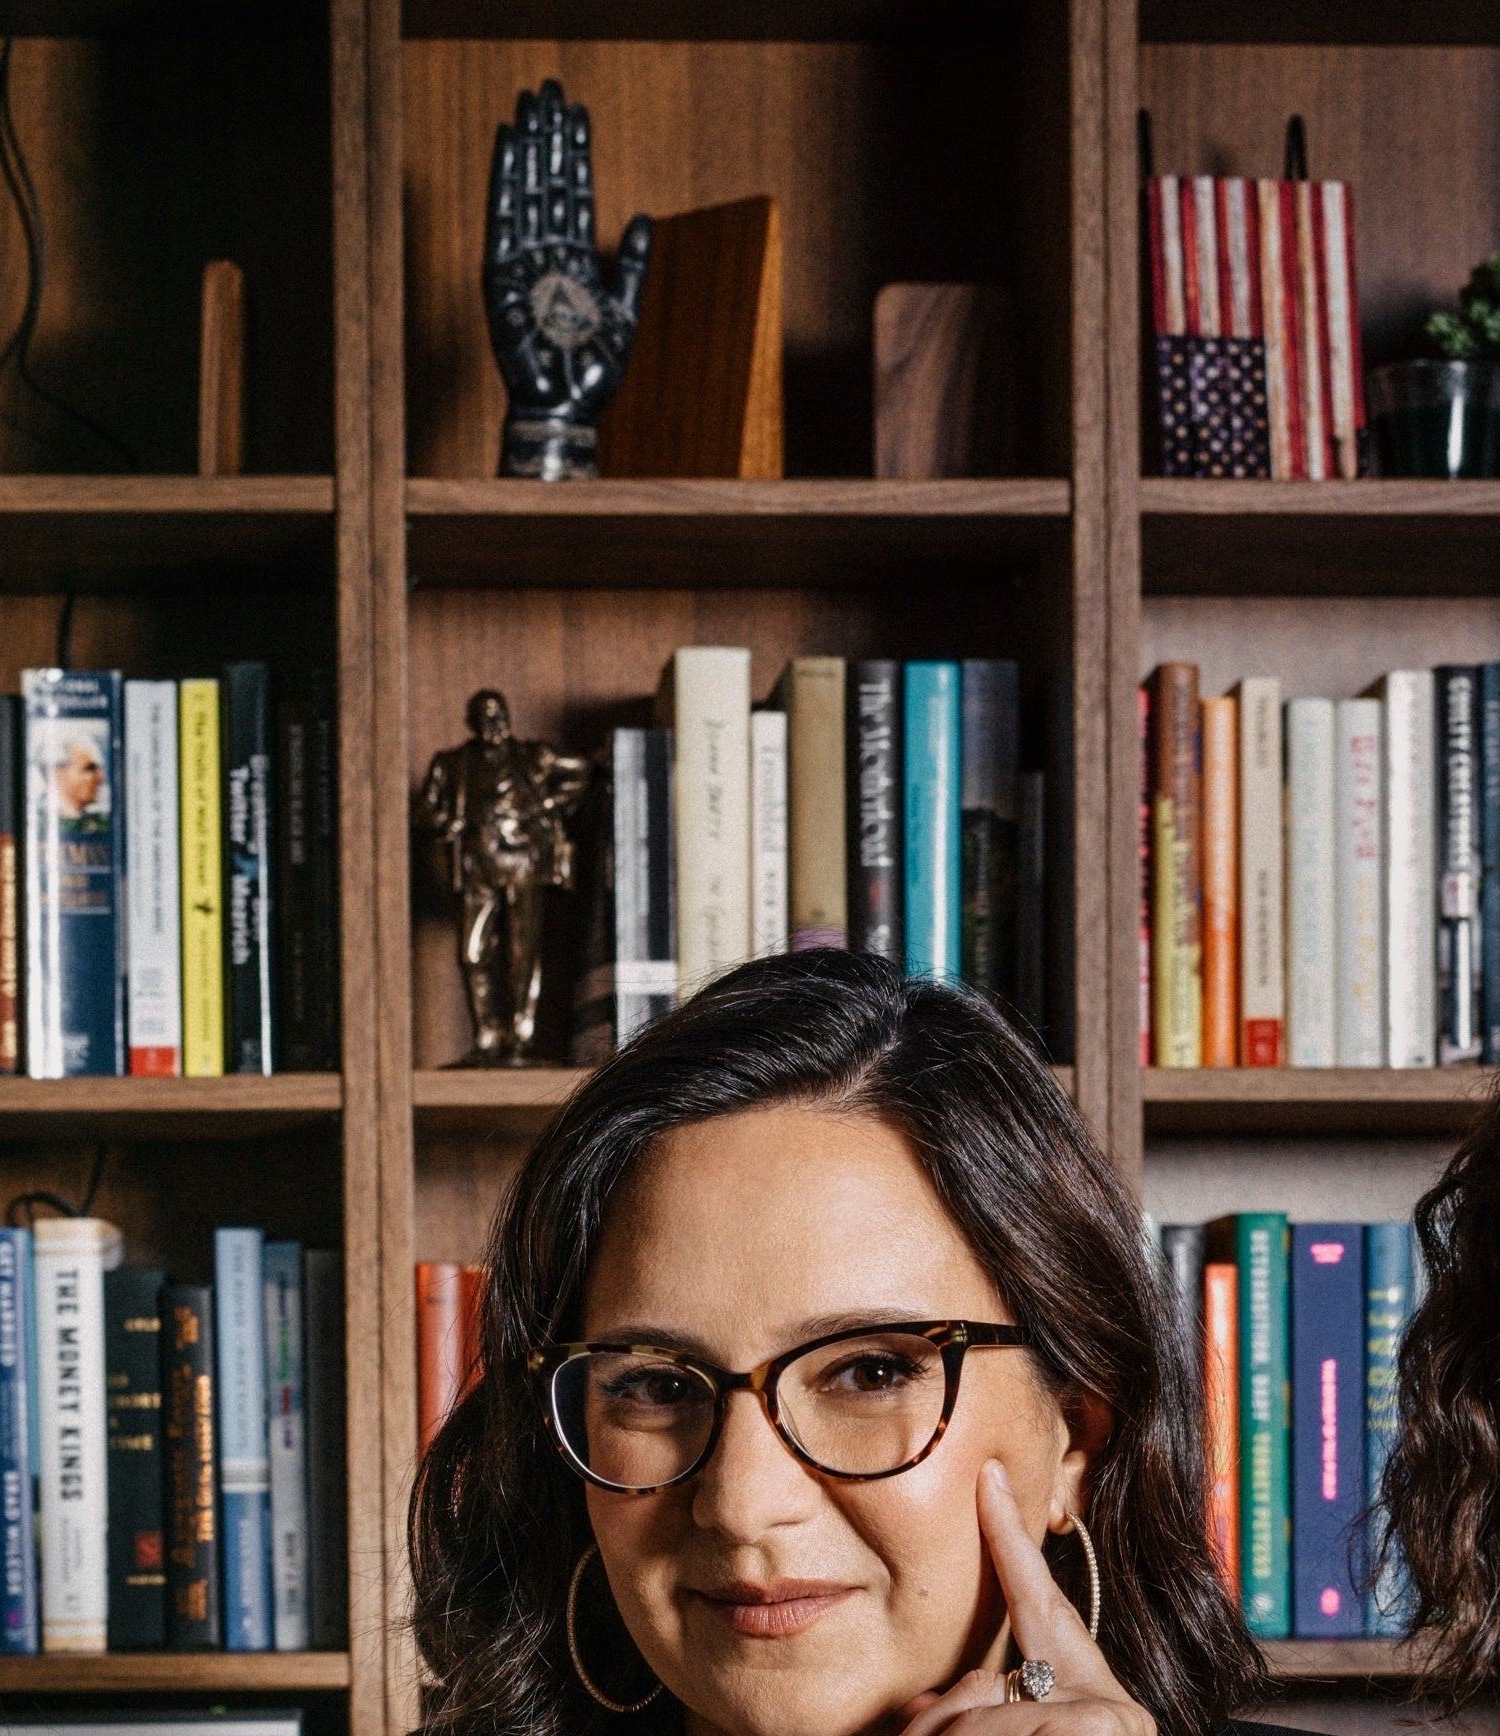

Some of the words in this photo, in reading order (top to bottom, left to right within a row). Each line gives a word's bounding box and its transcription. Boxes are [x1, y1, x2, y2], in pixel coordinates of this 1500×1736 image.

[859, 681, 893, 723] The
[1447, 676, 1472, 750] GUILTY
[229, 764, 249, 845] Twitter
[860, 725, 894, 868] Motherload
[1448, 752, 1473, 869] CREATURES
[232, 875, 251, 964] Mezrich
[56, 1267, 80, 1316] THE
[1251, 1230, 1271, 1367] DETRANSITION,
[57, 1328, 82, 1410] MONEY
[1251, 1372, 1272, 1421] BABY
[1367, 1289, 1402, 1431] ISRAEL
[3, 1469, 19, 1521] BRAD
[59, 1425, 83, 1502] KINGS
[1251, 1431, 1272, 1515] TORREY
[4, 1523, 23, 1597] WILCOX
[1251, 1517, 1273, 1580] PETERS
